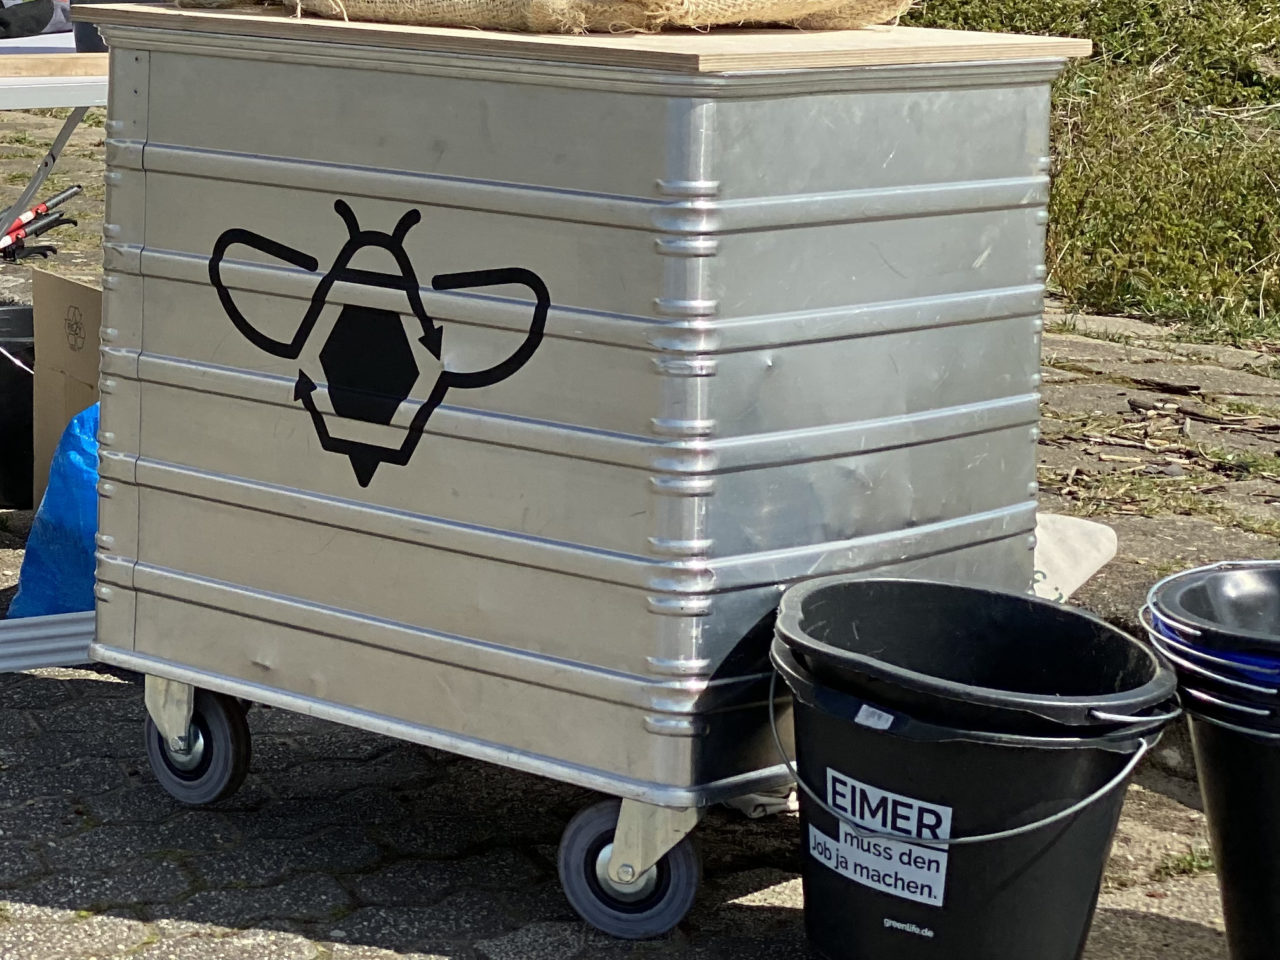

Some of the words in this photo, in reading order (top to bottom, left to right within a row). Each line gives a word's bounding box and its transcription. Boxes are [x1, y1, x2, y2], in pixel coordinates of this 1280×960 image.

[832, 775, 942, 840] EIMER
[812, 834, 832, 861] Job
[834, 848, 849, 870] ja
[854, 861, 937, 900] machen.
[844, 831, 893, 861] muss
[899, 848, 940, 873] den
